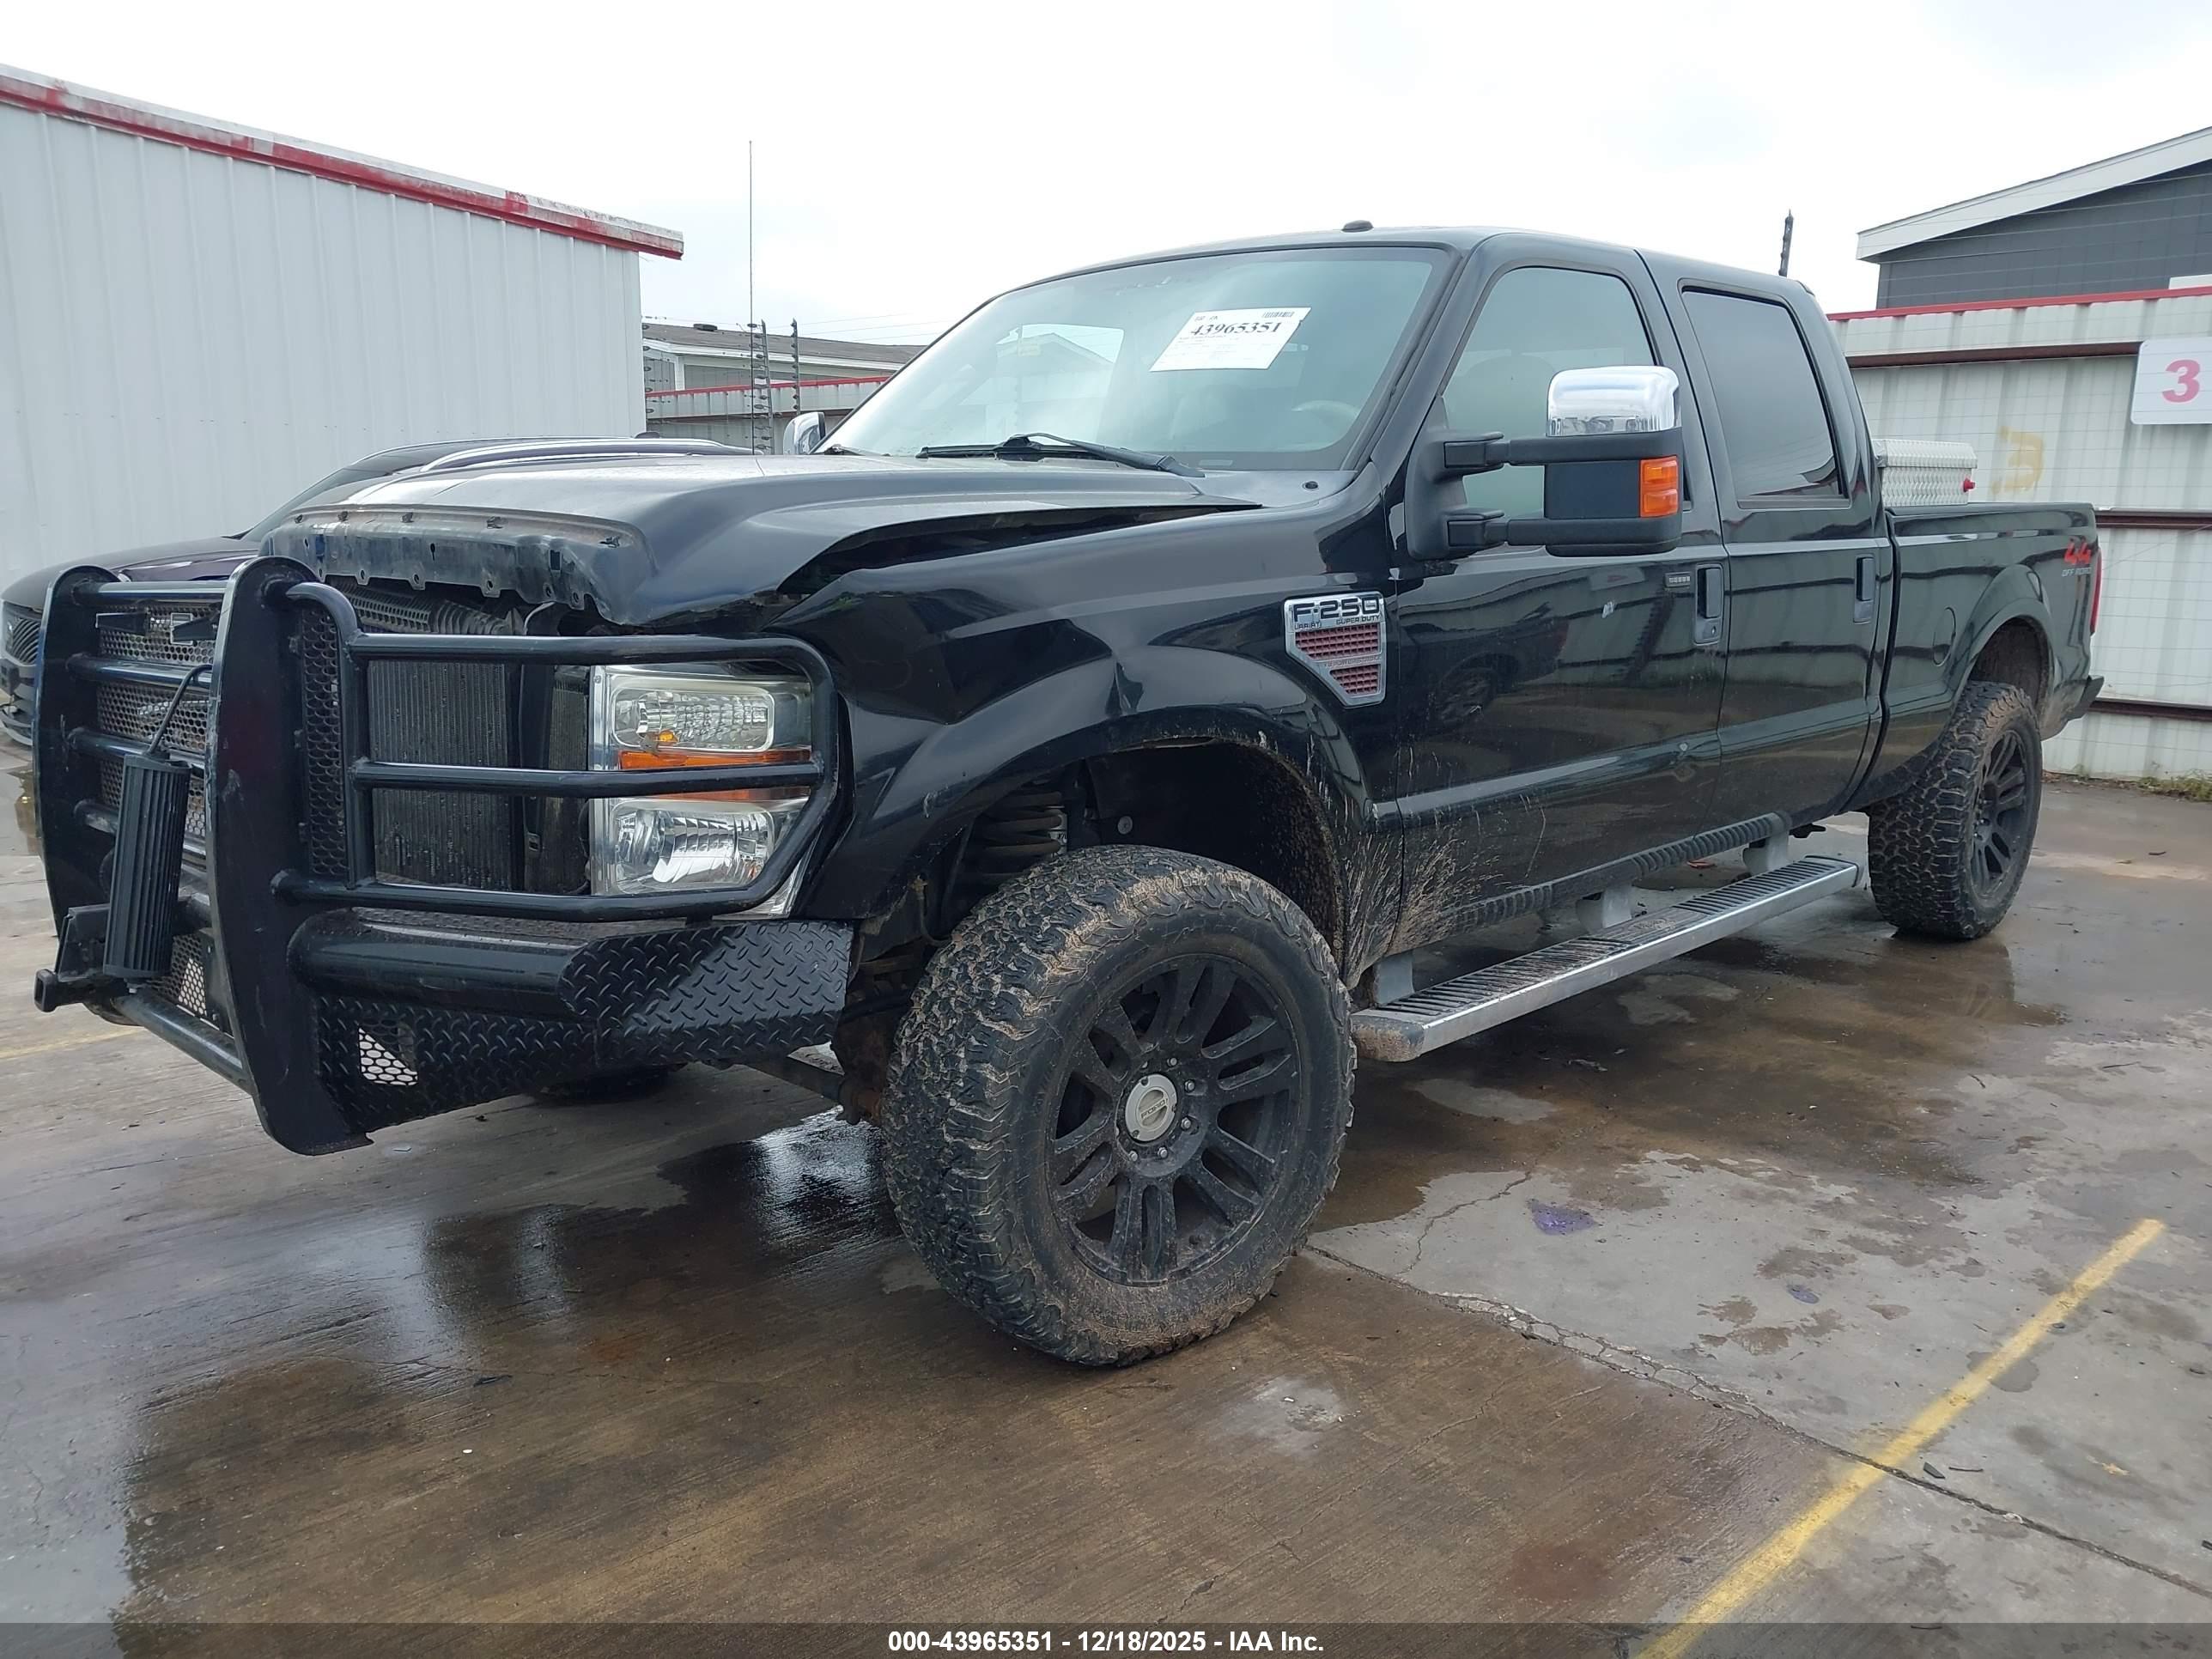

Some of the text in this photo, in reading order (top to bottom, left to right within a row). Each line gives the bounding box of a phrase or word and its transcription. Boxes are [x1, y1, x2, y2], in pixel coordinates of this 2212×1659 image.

[1191, 321, 1282, 336] 43965351
[2161, 359, 2201, 403] 3
[1293, 598, 1380, 623] F-250
